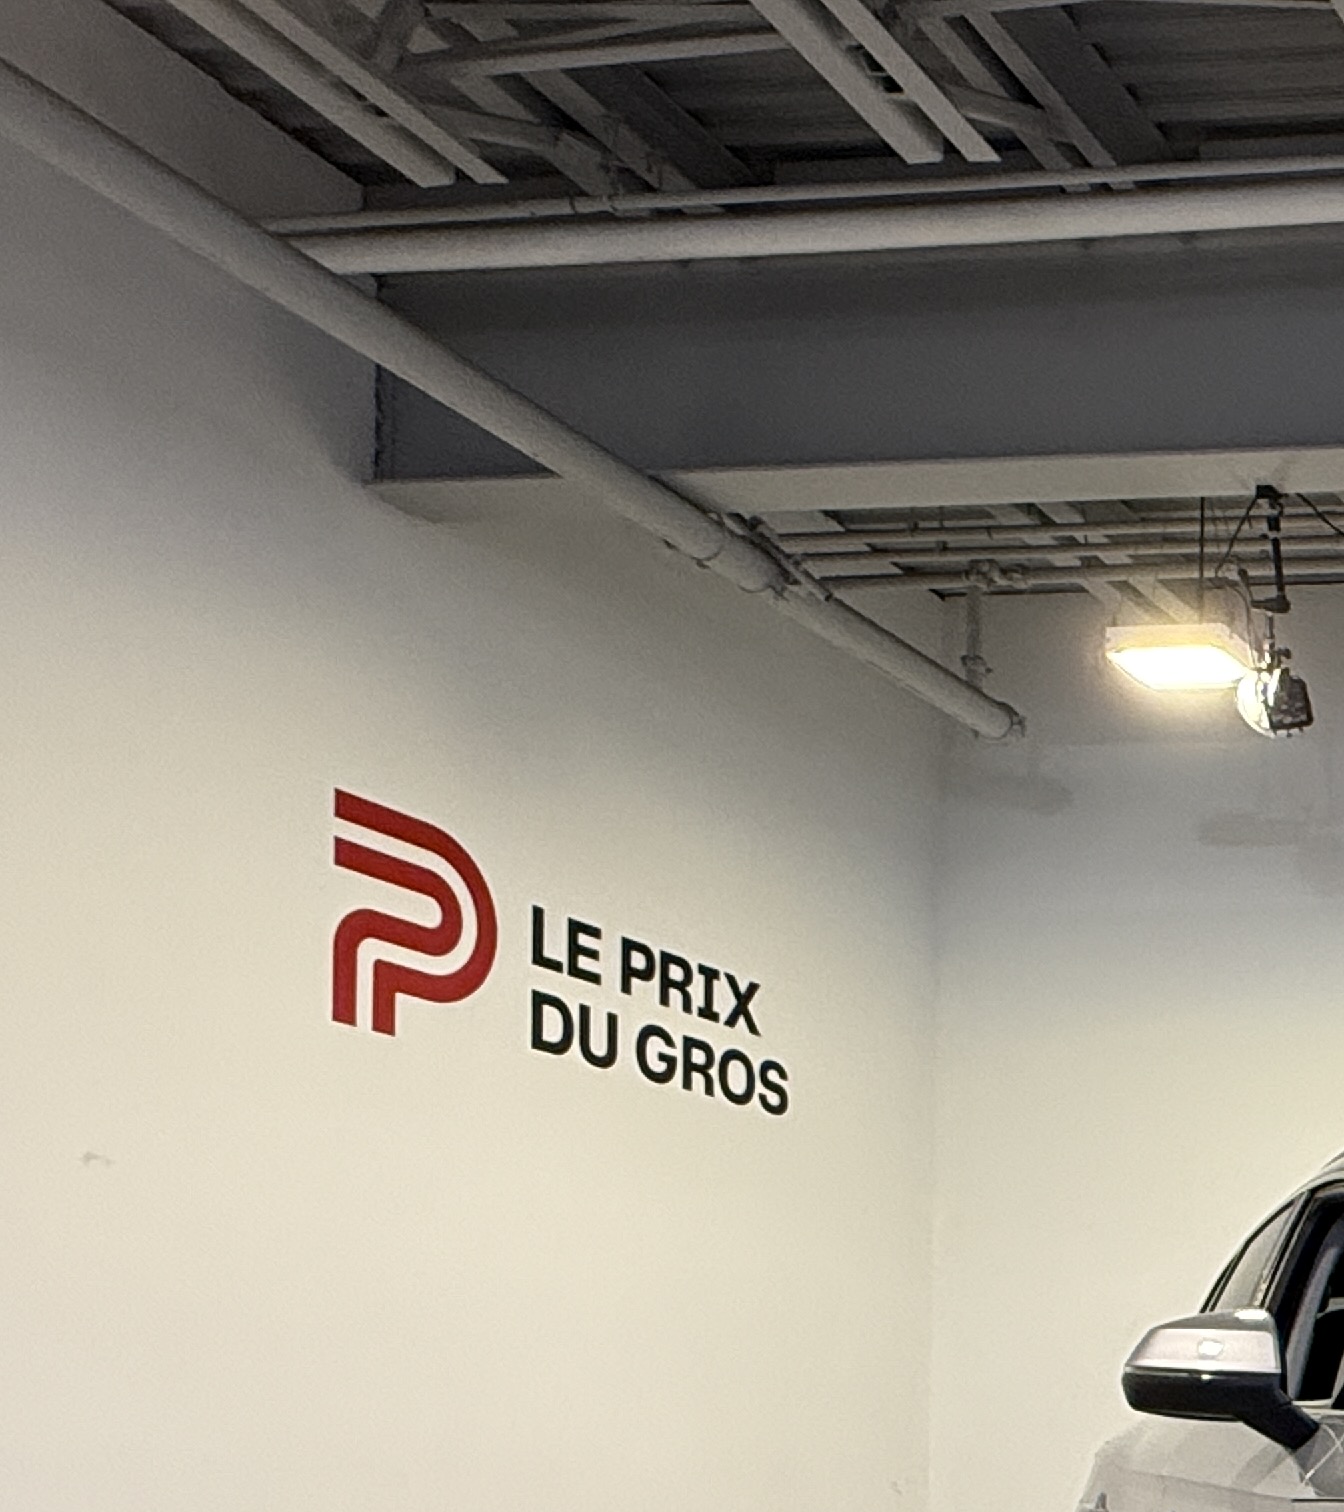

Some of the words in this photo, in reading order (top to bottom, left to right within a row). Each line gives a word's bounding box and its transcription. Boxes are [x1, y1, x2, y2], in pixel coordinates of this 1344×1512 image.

[531, 904, 602, 986] LE
[620, 936, 762, 1037] PRIX
[530, 988, 618, 1069] DU
[635, 1023, 789, 1116] GROS
